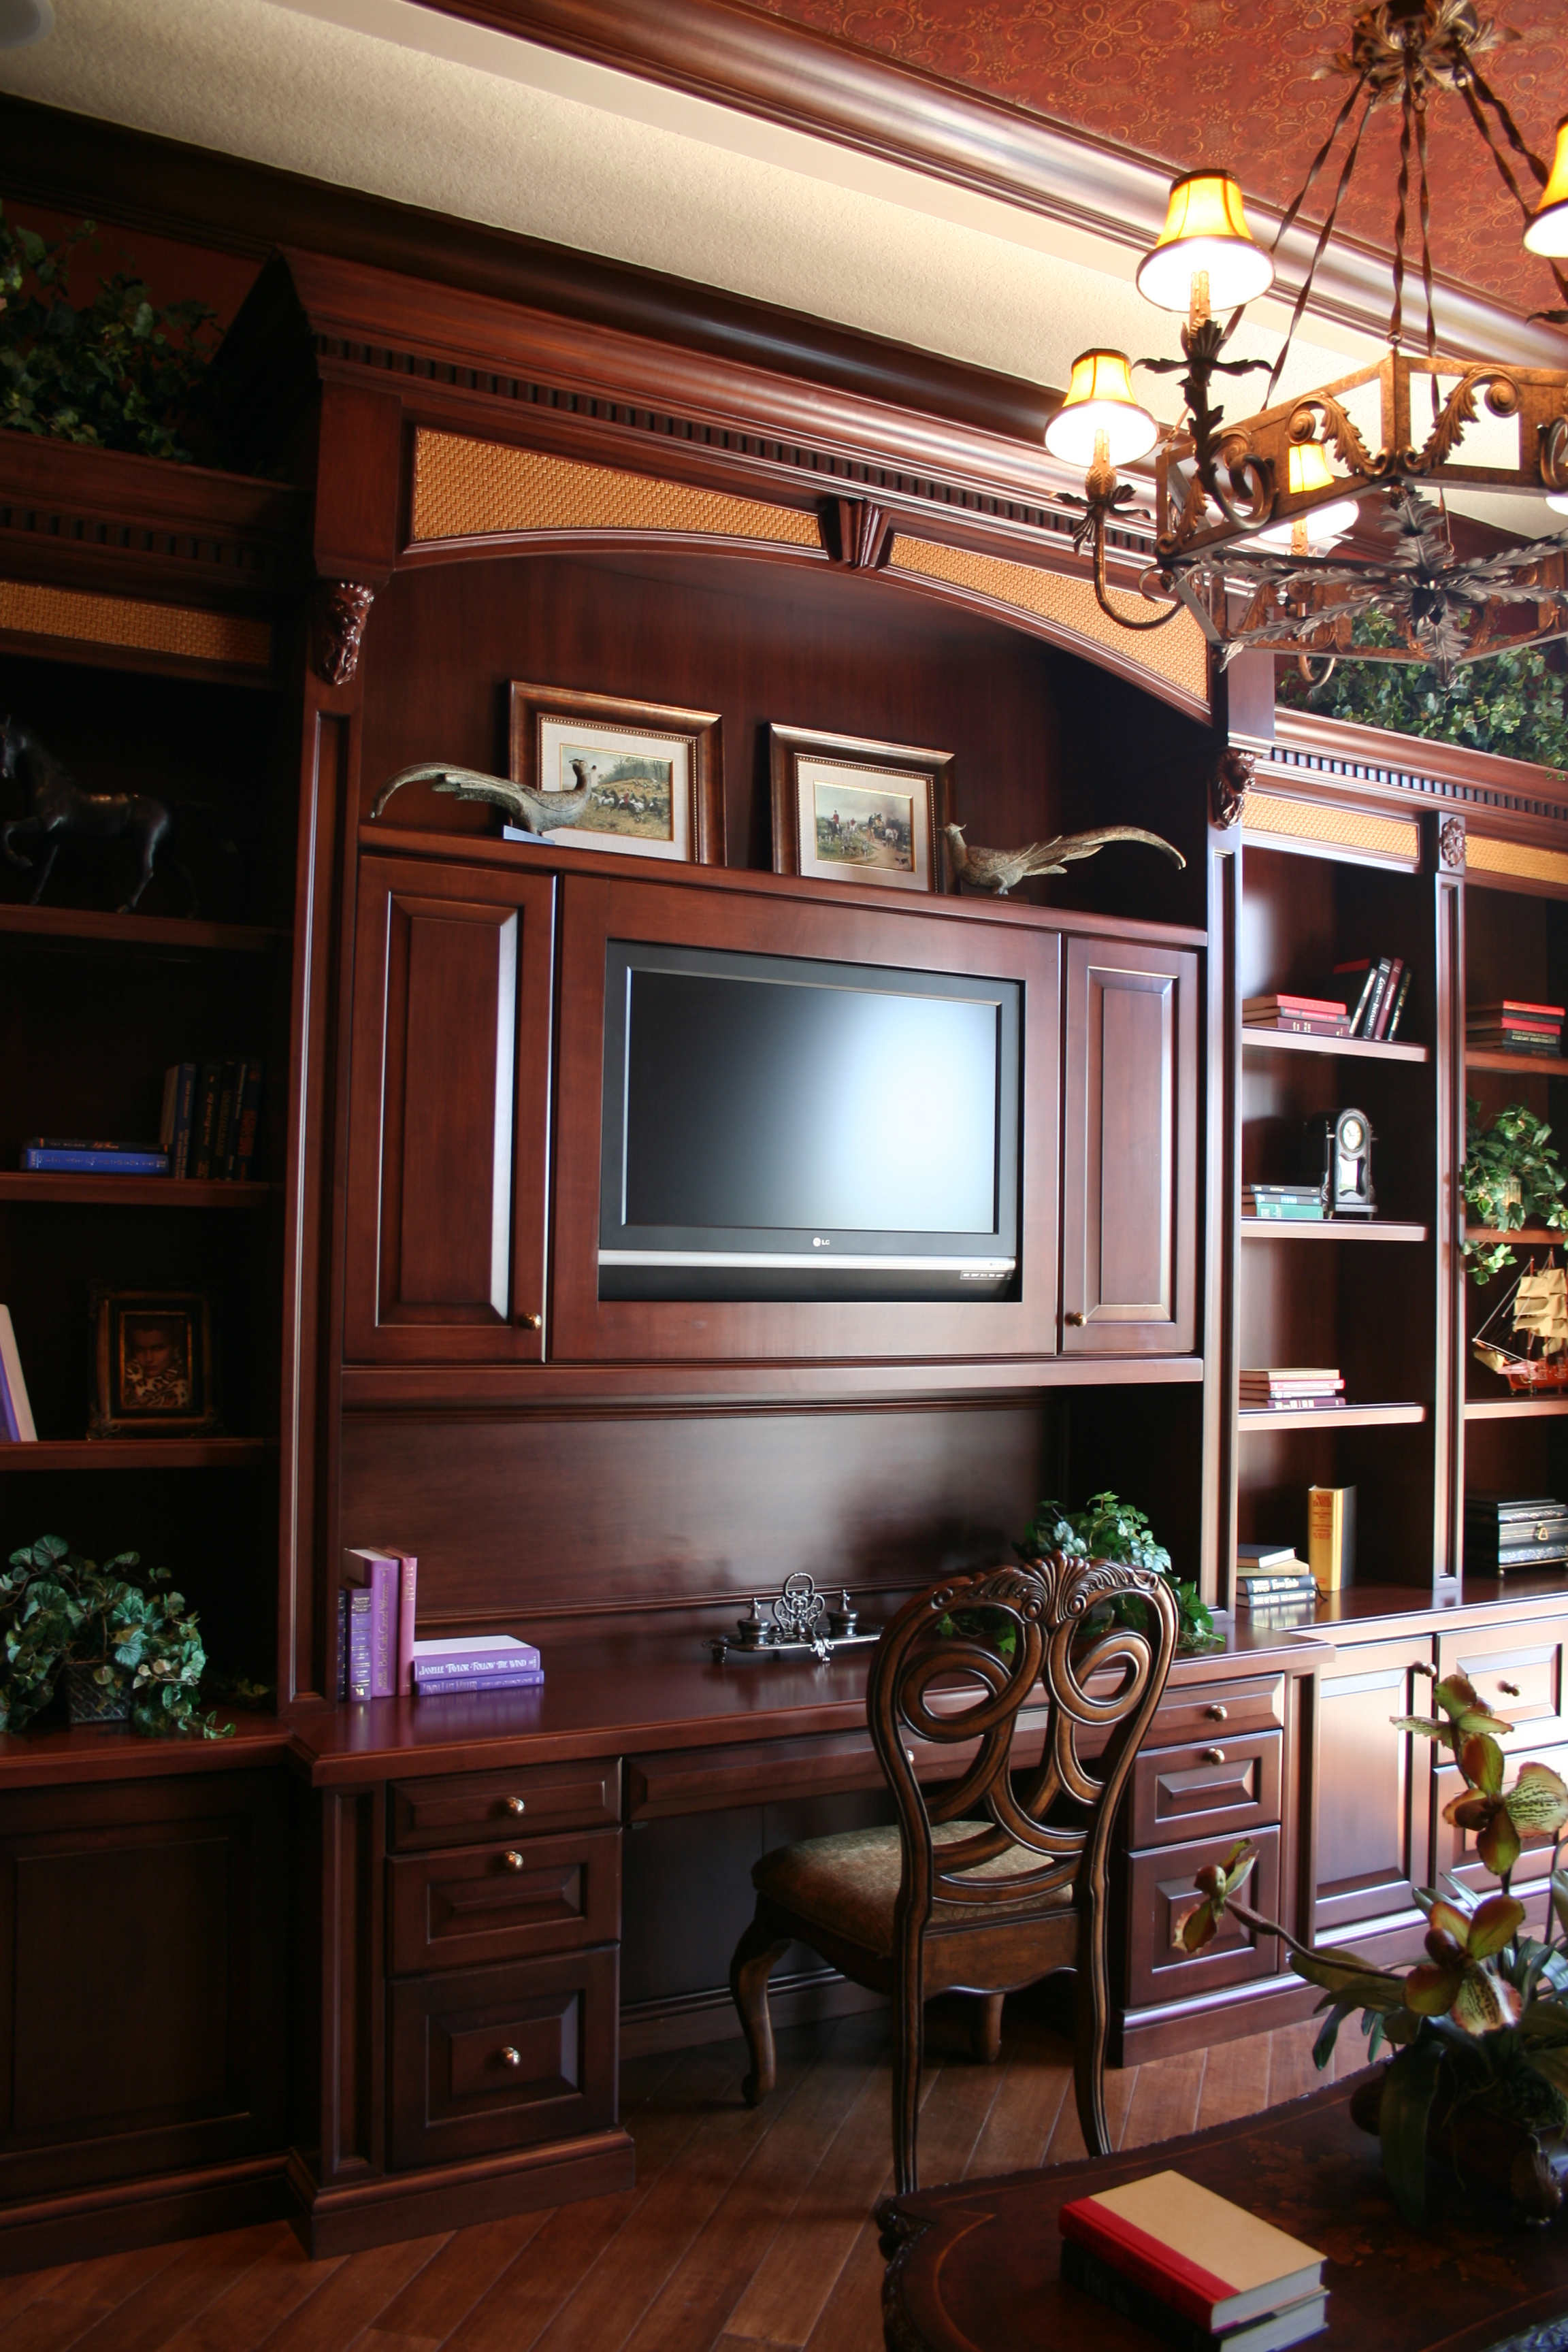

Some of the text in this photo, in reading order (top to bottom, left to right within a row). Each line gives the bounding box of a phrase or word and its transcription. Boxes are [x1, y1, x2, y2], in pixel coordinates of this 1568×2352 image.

[419, 1665, 444, 1676] JANELLE
[445, 1663, 470, 1673] TAYLOR
[472, 1661, 496, 1671] FOLLOW
[496, 1661, 508, 1669] THE
[509, 1659, 527, 1668] WIND
